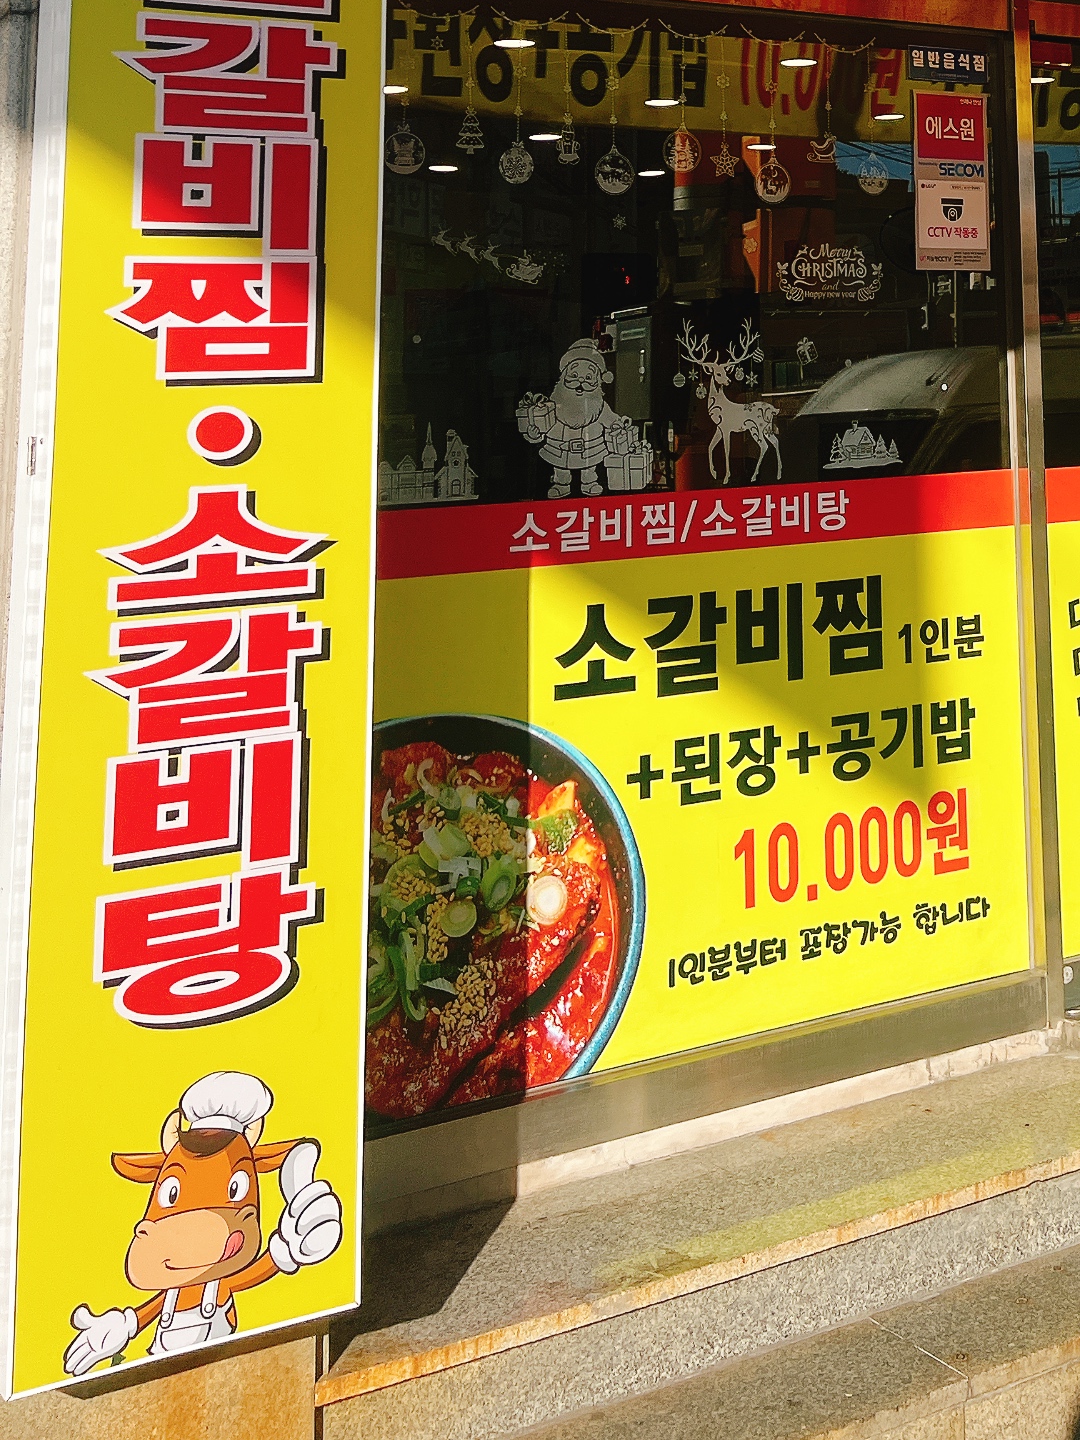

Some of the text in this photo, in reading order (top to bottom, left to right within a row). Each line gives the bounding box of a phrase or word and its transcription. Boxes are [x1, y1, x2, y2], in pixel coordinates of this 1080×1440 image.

[911, 49, 986, 72] 일반음식점
[925, 116, 975, 141] 에스원
[938, 163, 984, 178] SECOM
[927, 227, 979, 239] CCTV 작동중
[809, 243, 857, 261] Merry
[791, 257, 867, 283] CHRISTMAS
[821, 279, 840, 291] and
[509, 490, 850, 554] 소갈비찜/소갈비탕
[553, 574, 985, 701] 소갈비찜 1인분
[626, 697, 977, 806] +된장+공기밥
[734, 787, 970, 909] 10.000원
[668, 896, 991, 988] 1인분부터 포장가능 합니다
